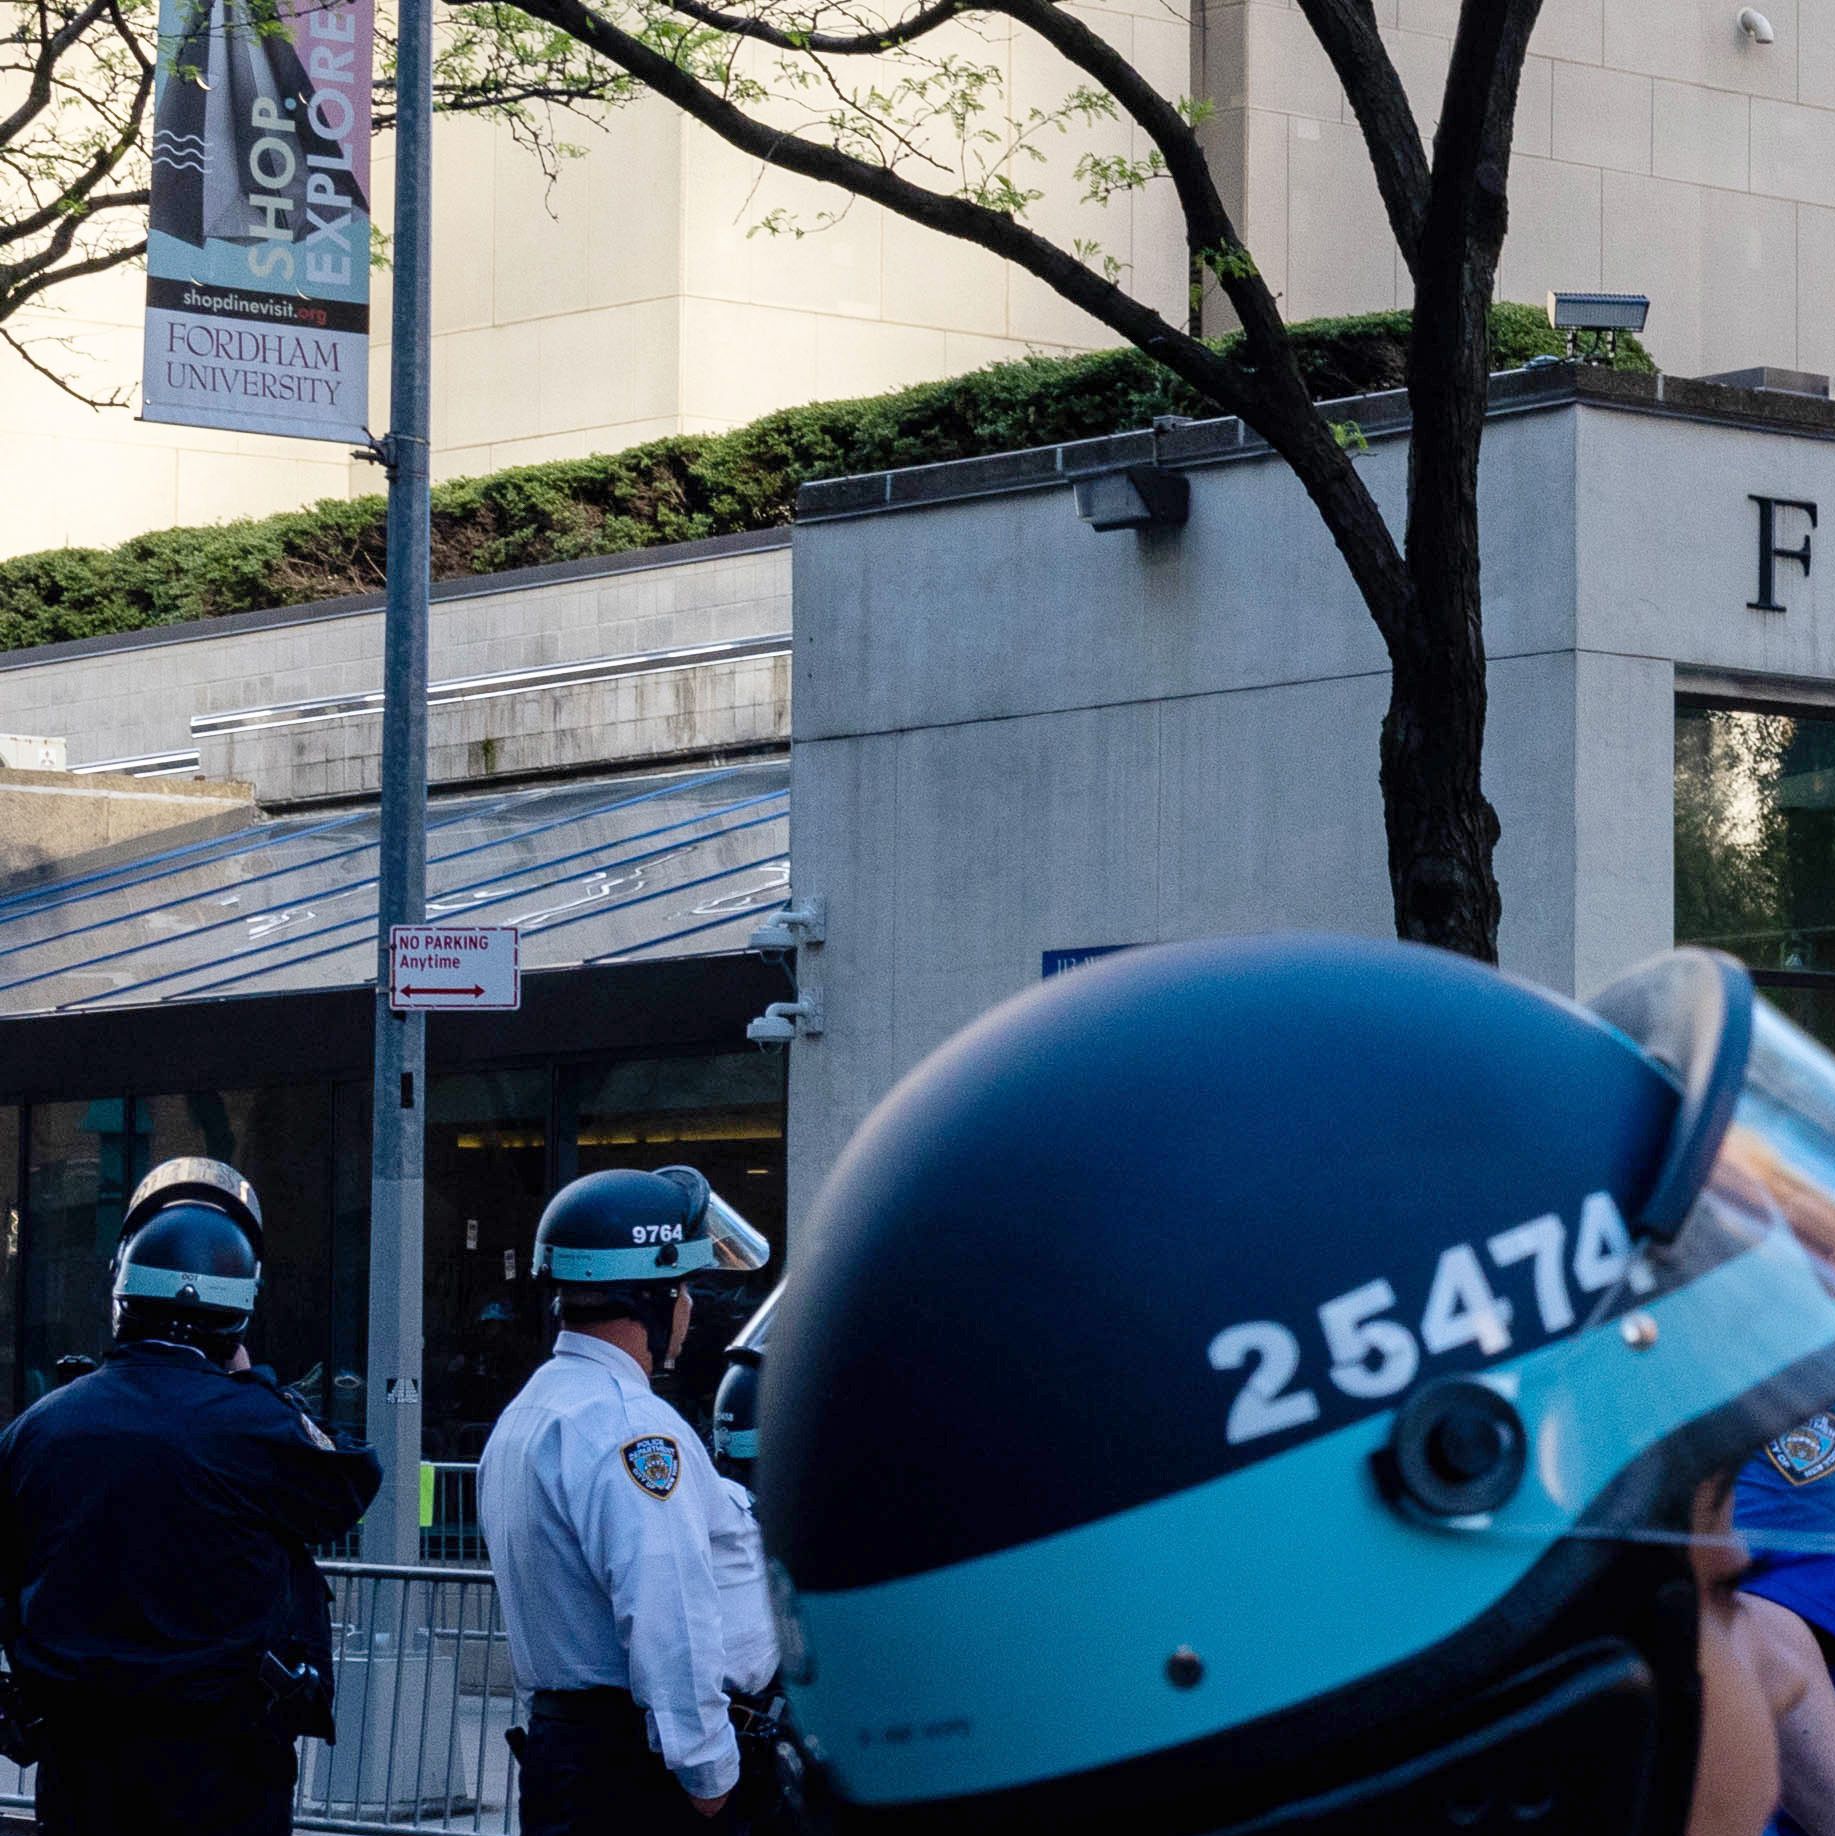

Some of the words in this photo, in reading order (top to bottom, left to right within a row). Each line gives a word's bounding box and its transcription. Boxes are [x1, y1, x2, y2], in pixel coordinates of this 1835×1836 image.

[305, 12, 356, 286] EXPLORE
[183, 288, 328, 326] shopdinevisit.org
[167, 321, 342, 373] FORDHAM
[166, 361, 342, 406] UNIVERSITY
[399, 935, 420, 950] NO
[424, 935, 489, 950] PARKING
[400, 954, 461, 971] Anytime
[632, 1224, 683, 1244] 9764
[1208, 1191, 1656, 1447] 25474
